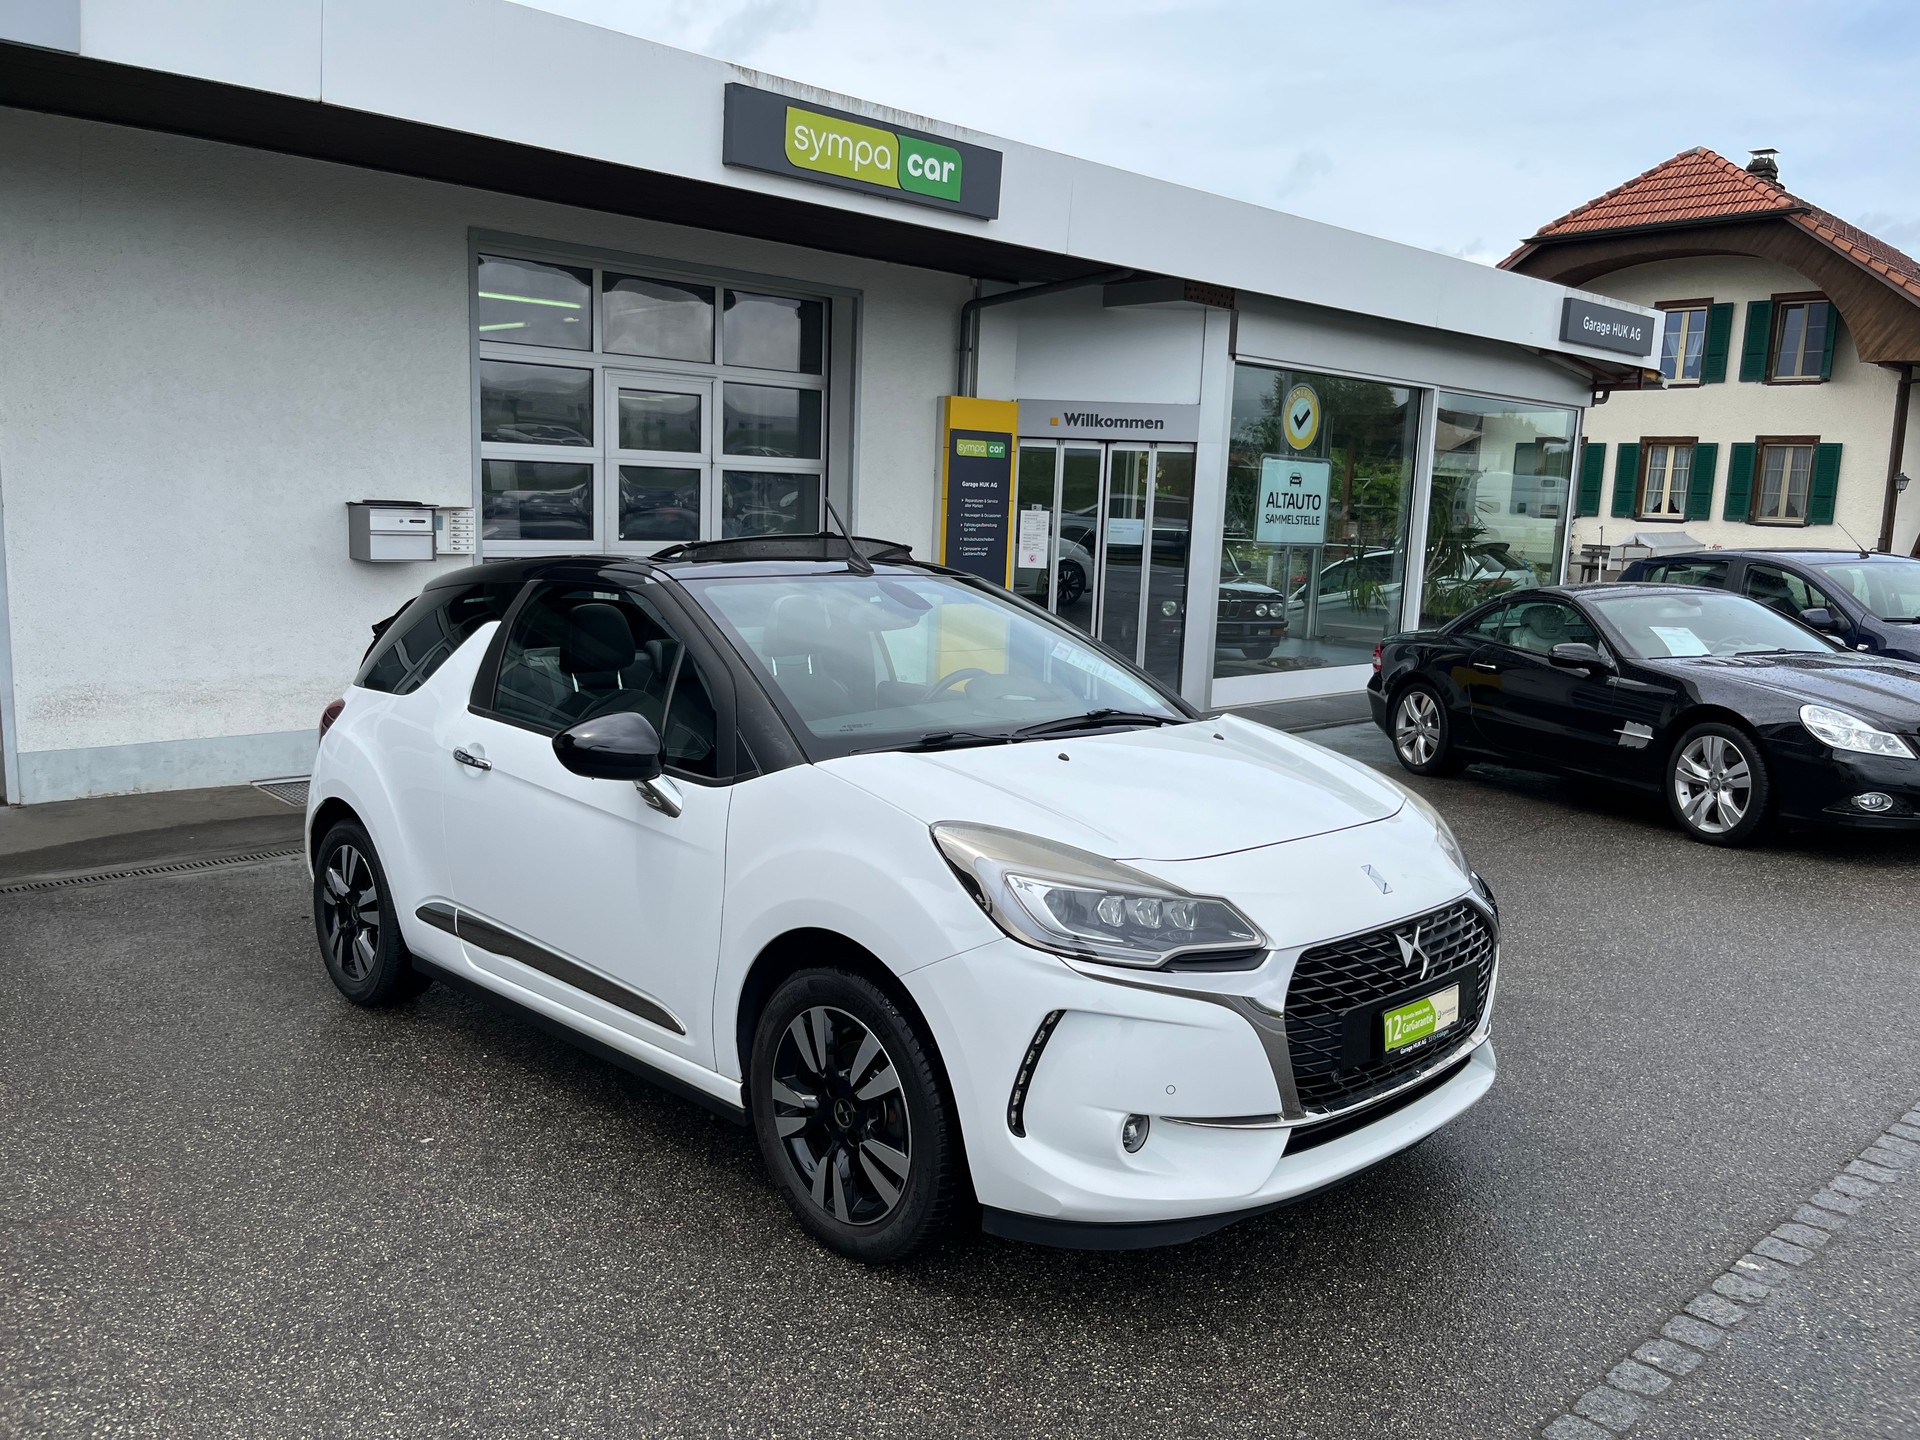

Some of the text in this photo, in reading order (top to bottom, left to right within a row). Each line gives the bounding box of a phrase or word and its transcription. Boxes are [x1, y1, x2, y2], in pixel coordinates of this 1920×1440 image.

[794, 124, 955, 183] sympa car
[1583, 316, 1641, 341] Garage HUK AG
[1063, 412, 1165, 430] Willkommen
[959, 443, 1004, 454] sympa car
[1265, 491, 1322, 511] ALTAUTO
[1264, 513, 1321, 526] SAMMELSTELLE
[1385, 1014, 1402, 1043] 12
